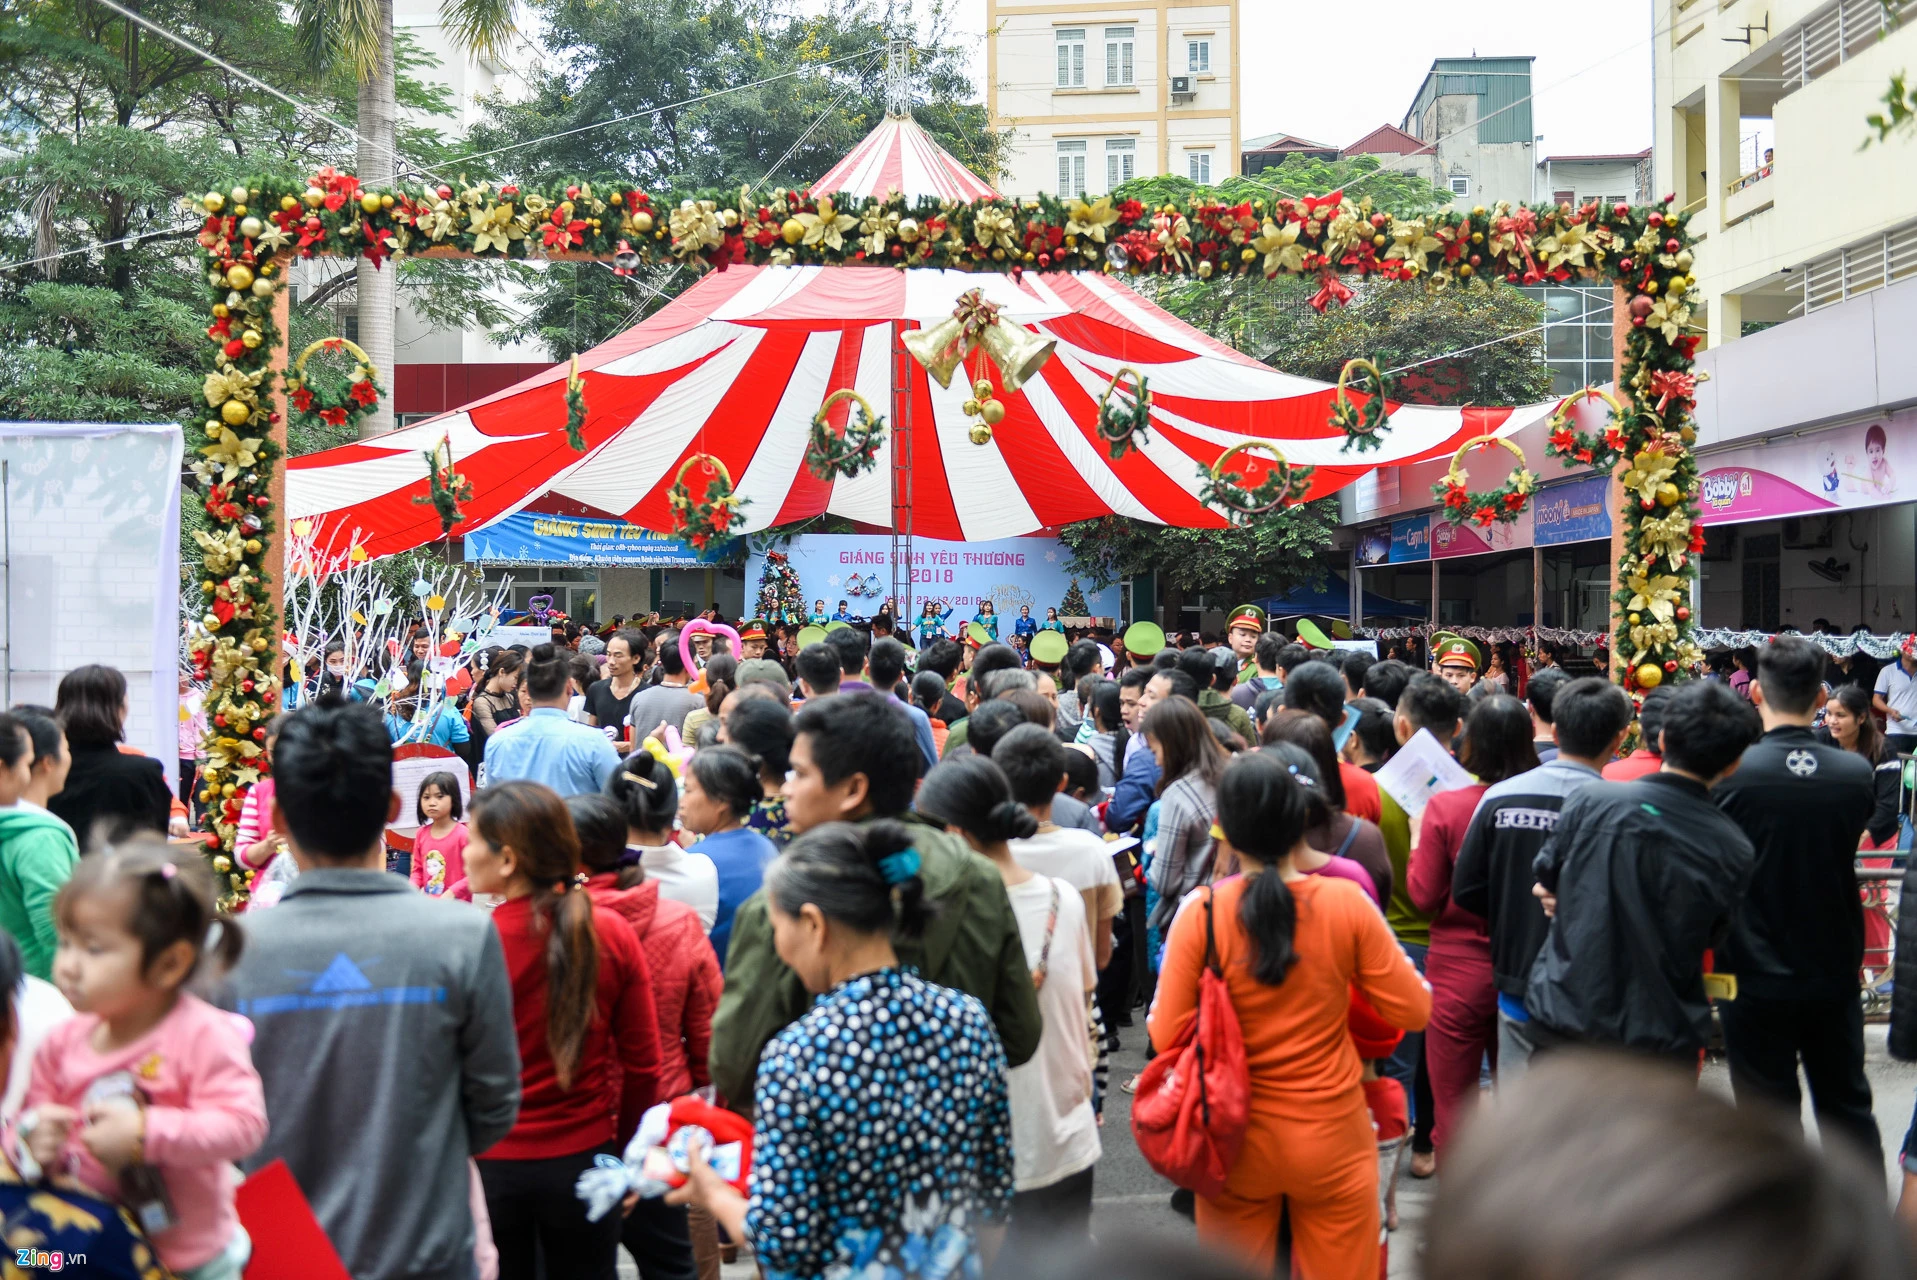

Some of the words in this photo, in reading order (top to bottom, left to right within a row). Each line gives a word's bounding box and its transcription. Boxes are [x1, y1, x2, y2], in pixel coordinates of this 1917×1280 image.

[1703, 474, 1738, 503] Bobby
[1536, 503, 1563, 525] moony
[839, 549, 885, 565] GIÁNG
[932, 550, 958, 566] YÊU
[963, 550, 1025, 567] THƯƠNG
[911, 568, 954, 583] 2018
[1495, 808, 1560, 831] Ferr
